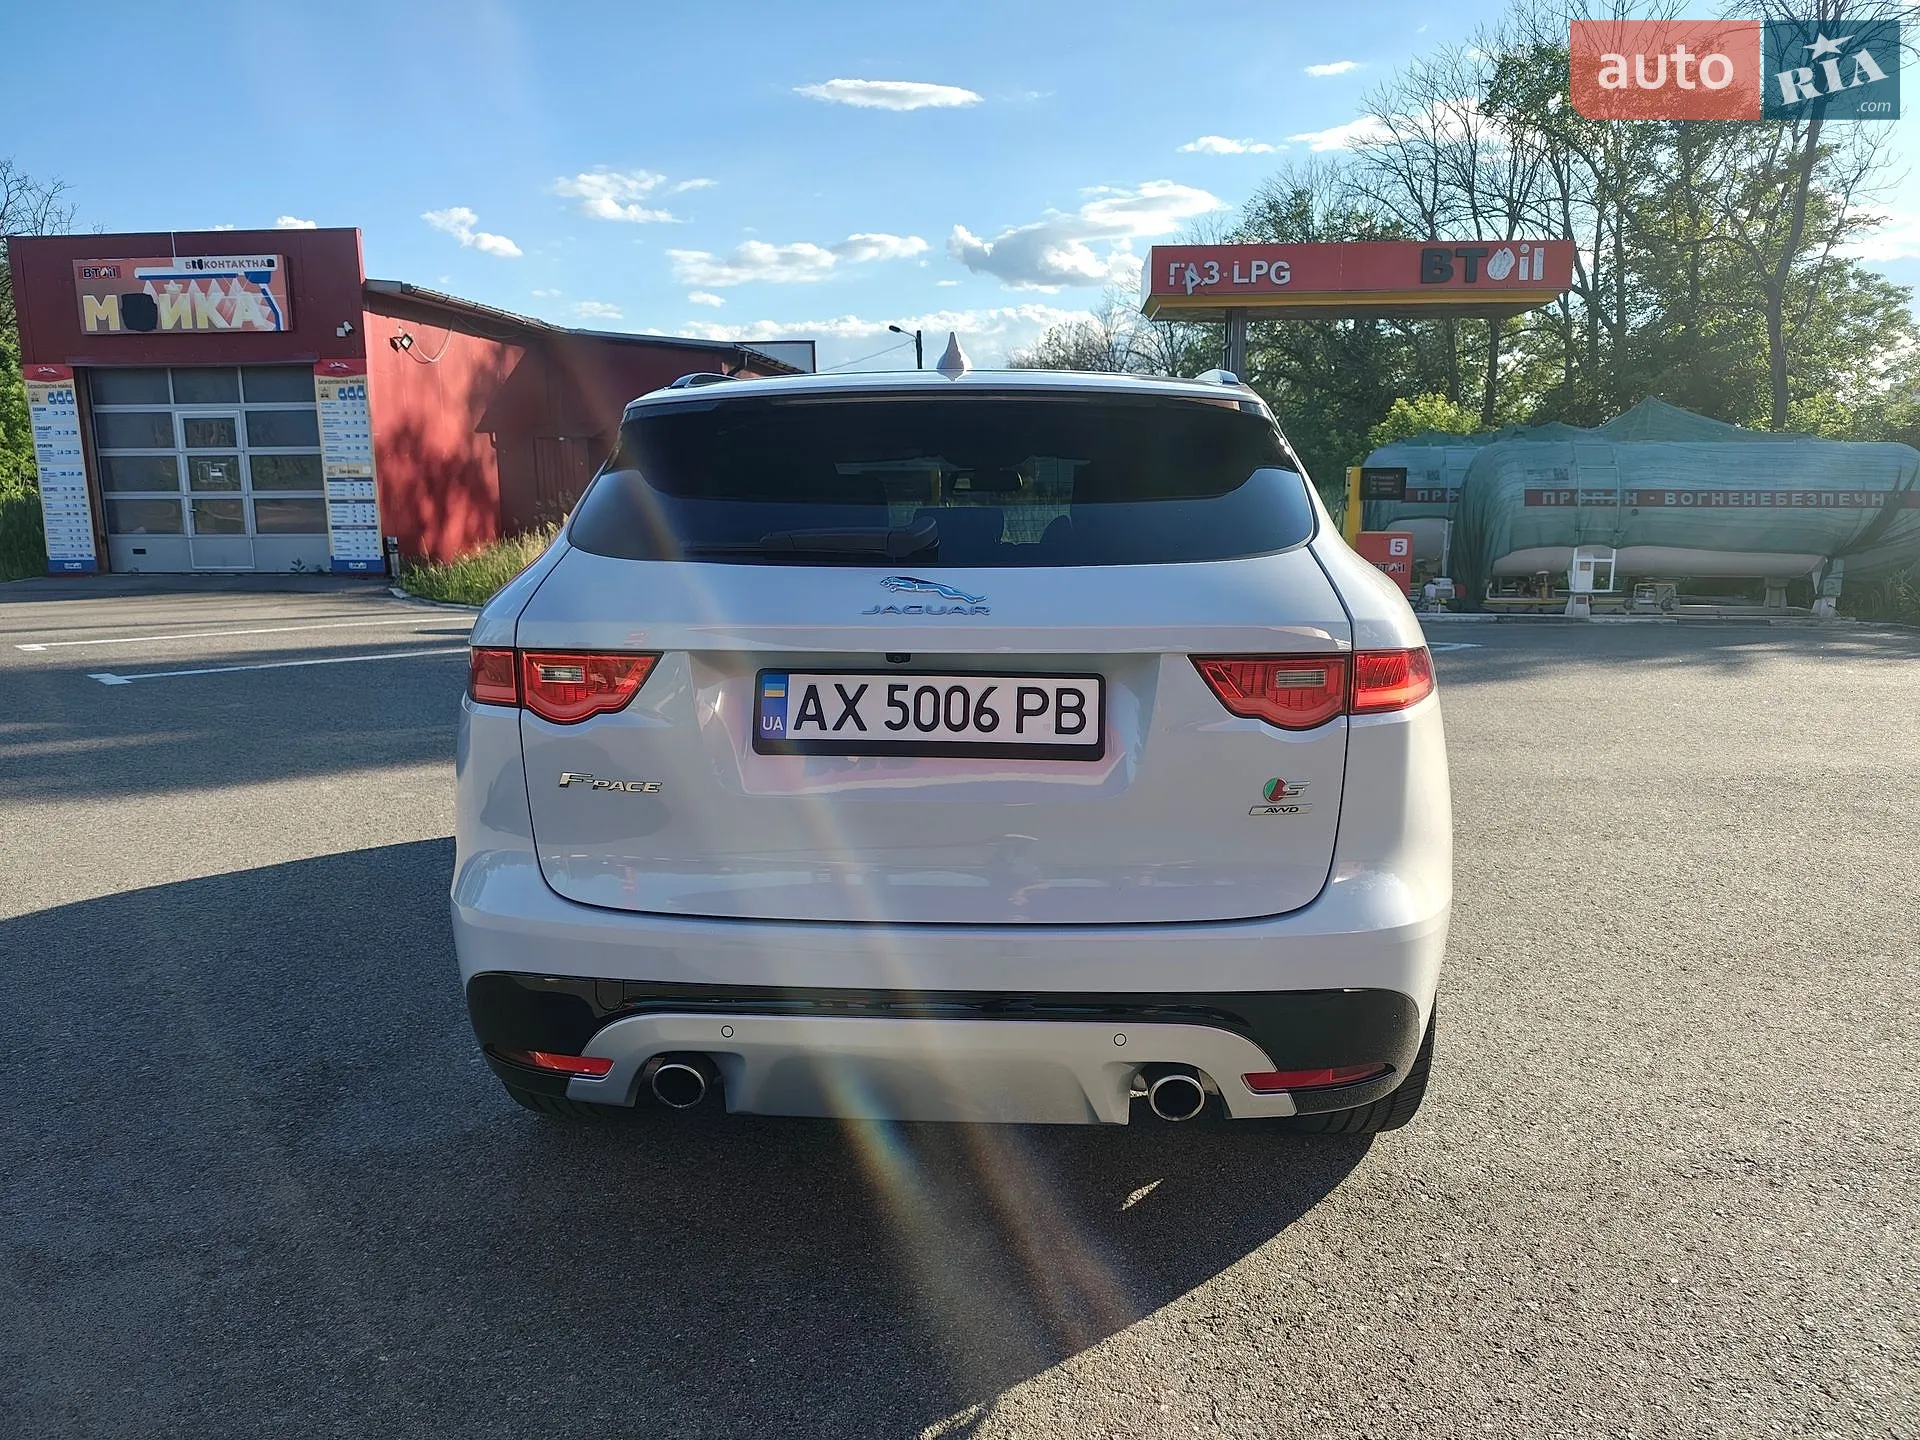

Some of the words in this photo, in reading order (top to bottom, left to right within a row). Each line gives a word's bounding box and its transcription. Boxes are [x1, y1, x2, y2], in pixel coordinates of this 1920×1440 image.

[185, 258, 275, 270] БКОНТАКТНА
[82, 280, 269, 332] МЙКА
[1394, 541, 1404, 552] 5
[860, 605, 991, 616] JAGUAR
[793, 683, 869, 732] AX
[883, 684, 1001, 733] 5006
[1015, 686, 1087, 735] PB
[763, 716, 784, 731] UA
[559, 771, 663, 793] F-PACE
[1264, 806, 1299, 814] AWD
